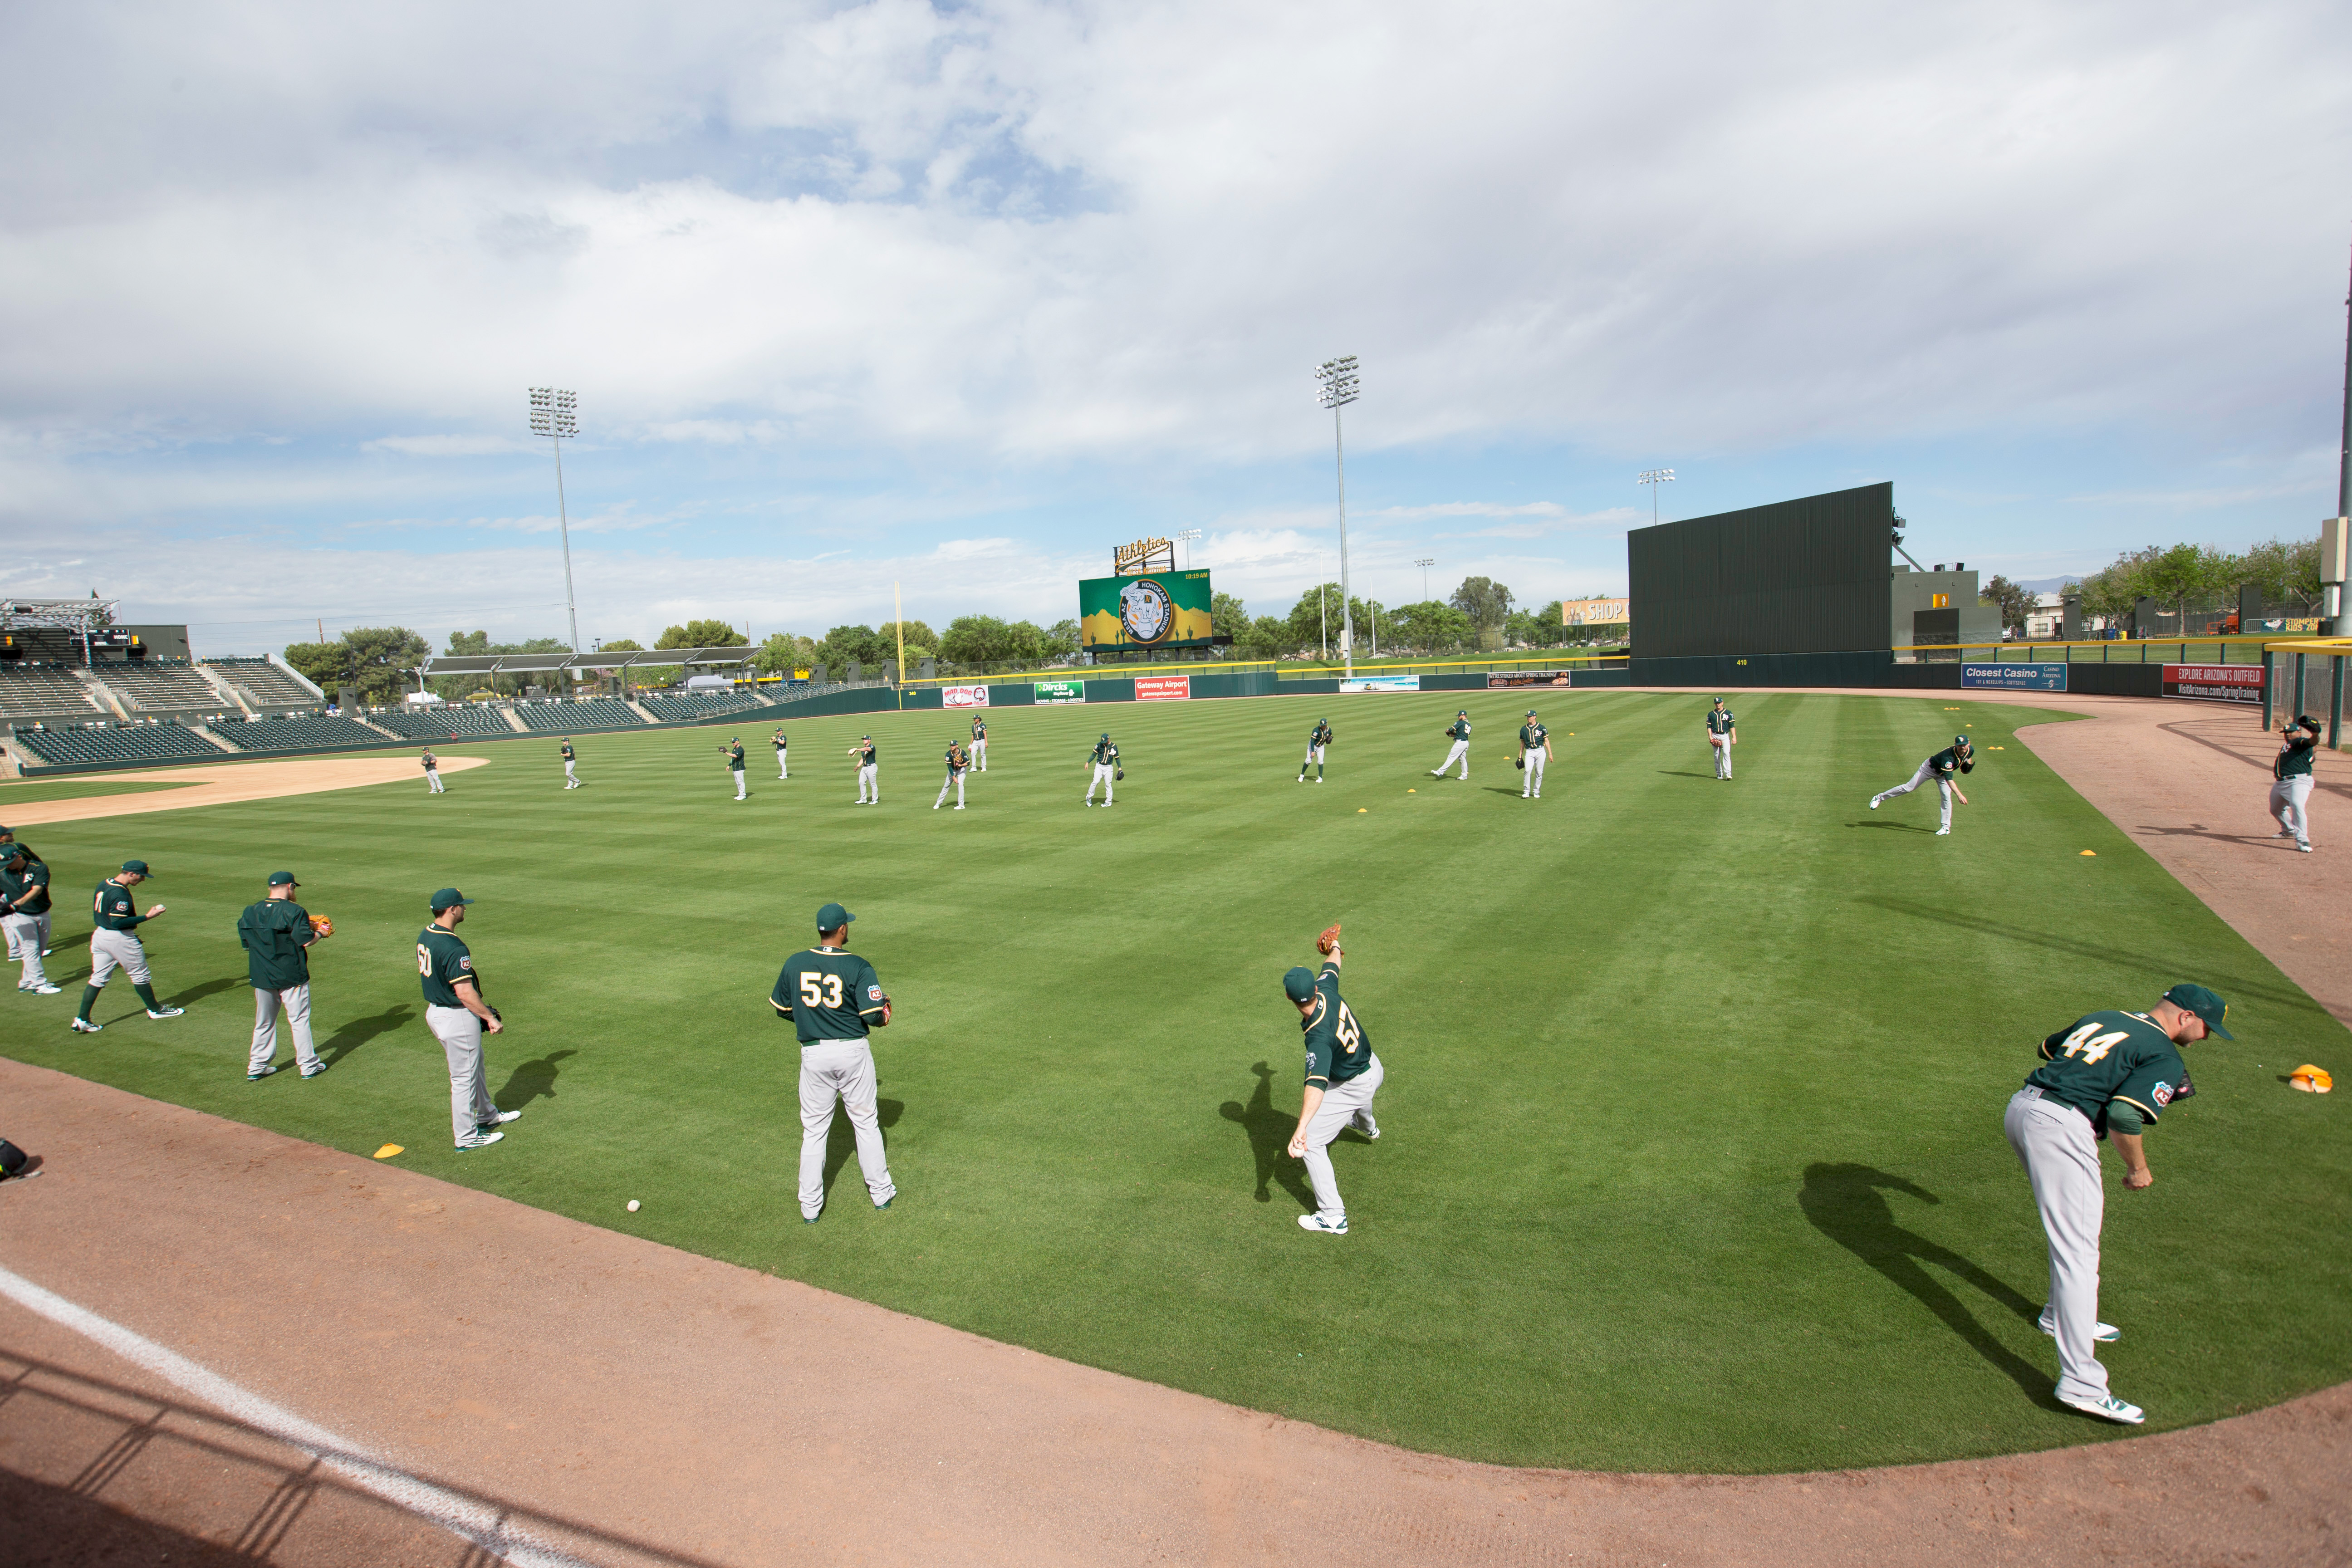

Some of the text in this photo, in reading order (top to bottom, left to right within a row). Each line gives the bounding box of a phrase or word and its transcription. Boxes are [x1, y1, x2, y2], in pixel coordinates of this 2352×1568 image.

[1114, 536, 1166, 566] Athletics
[1127, 566, 1167, 577] MESA ARIZONA
[1142, 582, 1170, 633] HOHOKAM STADIUM
[1588, 603, 1622, 620] SHOP
[1121, 603, 1134, 635] MESA, AZ
[1966, 668, 2037, 678] Closest Casino
[2178, 668, 2259, 682] EXPLORE ARIZONA'S OUTFIELD
[945, 688, 972, 697] MAD DOG
[1042, 683, 1068, 691] Dircks
[1165, 681, 1187, 689] Airport
[2178, 684, 2259, 701] VisitArizona.com/SpringTraining
[417, 943, 432, 978] 60
[800, 972, 843, 1009] 53
[1336, 1000, 1360, 1054] 57
[2061, 1022, 2130, 1065] 44
[2156, 1091, 2168, 1103] AZ
